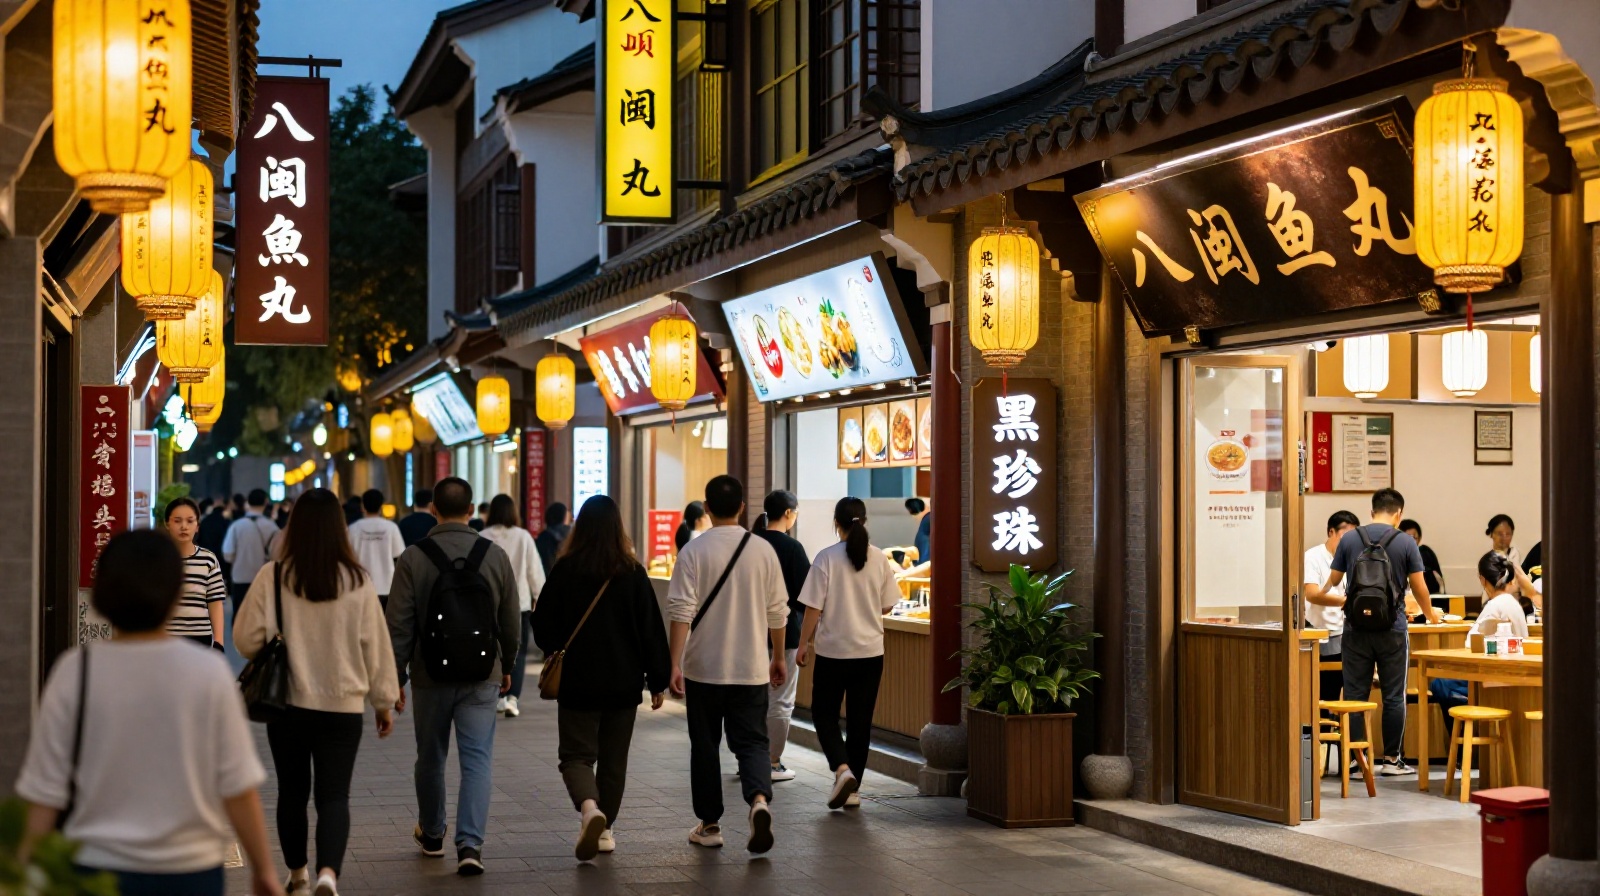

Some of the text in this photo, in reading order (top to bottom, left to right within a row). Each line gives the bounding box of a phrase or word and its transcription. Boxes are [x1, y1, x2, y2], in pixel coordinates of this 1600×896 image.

[253, 101, 315, 324] 八闽魚丸
[1132, 166, 1417, 288] 八闽鱼丸
[991, 394, 1044, 556] 黑珍珠
